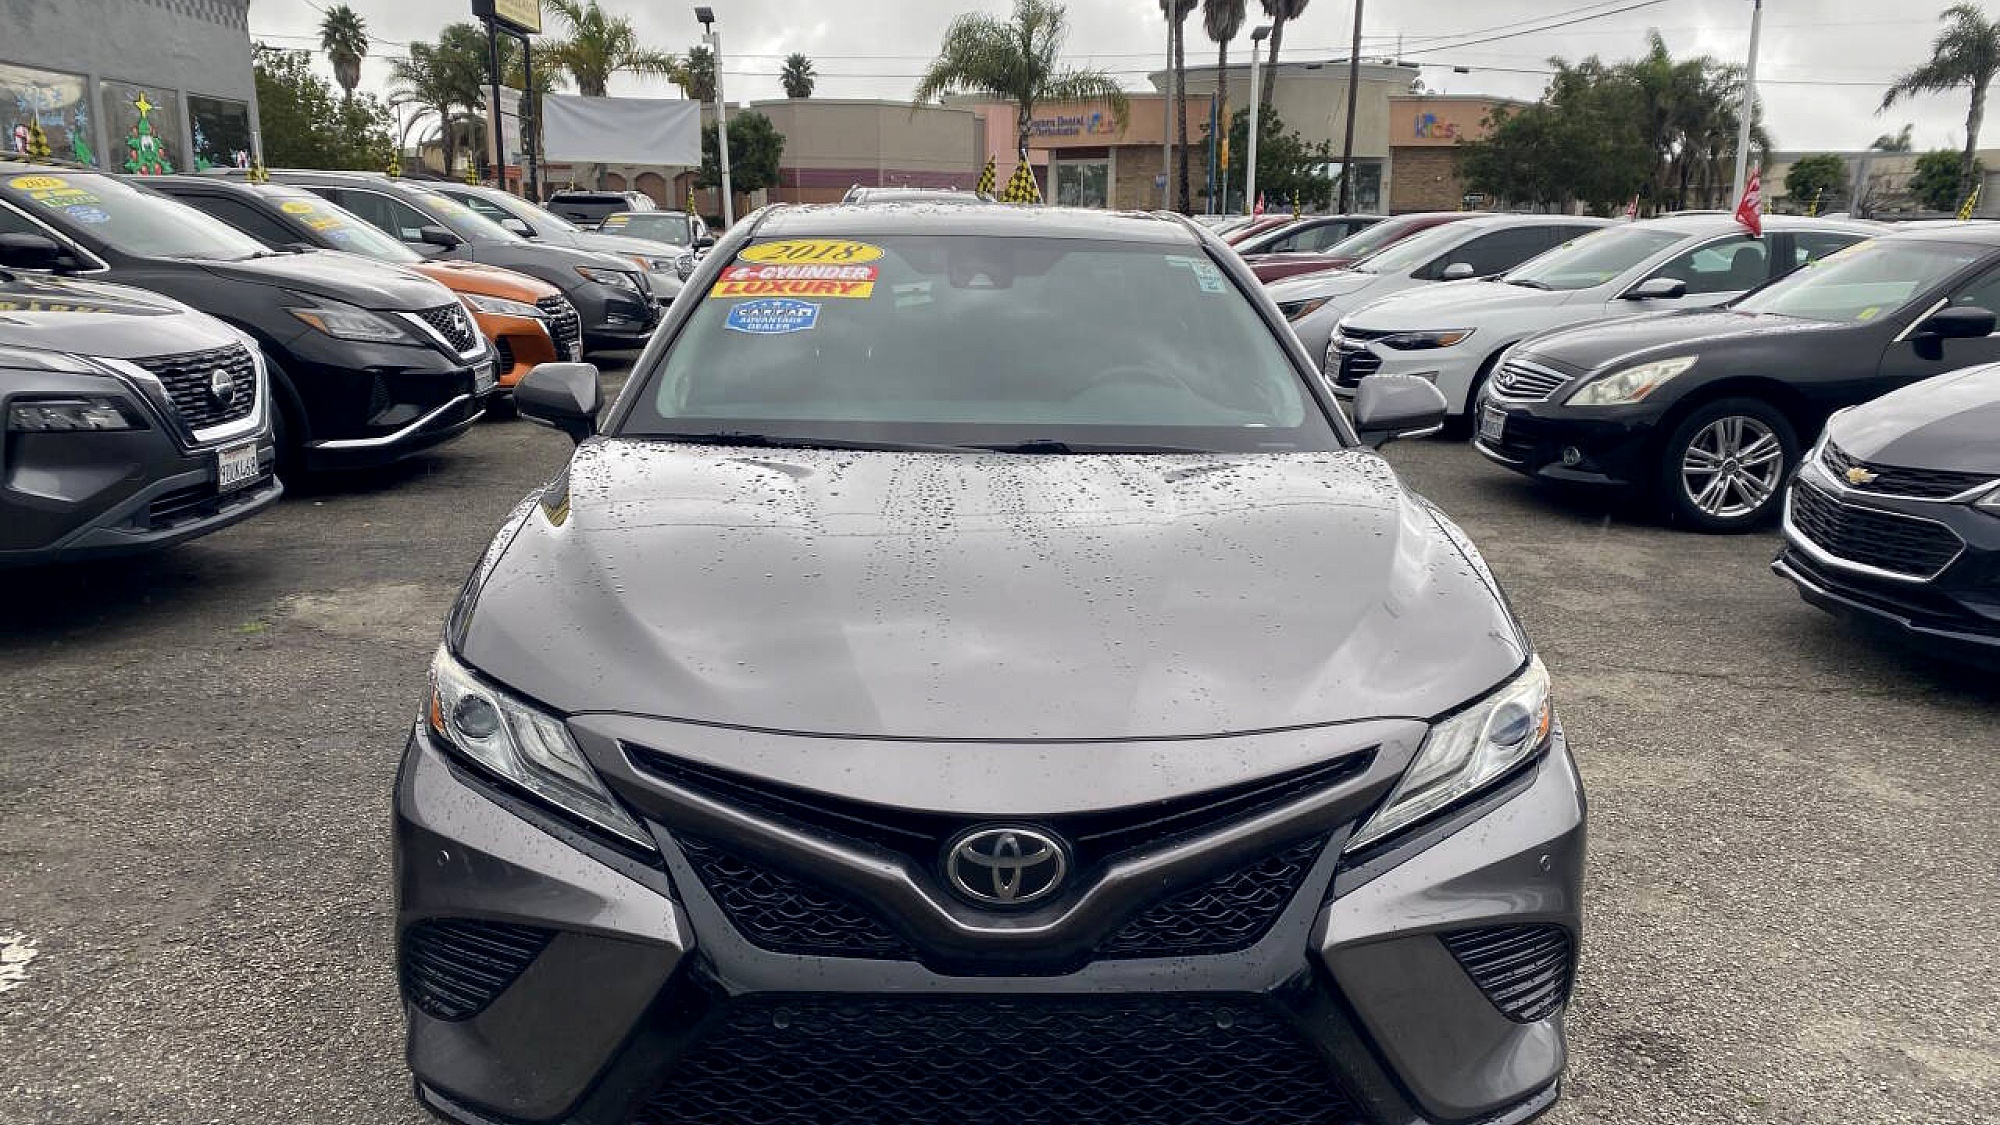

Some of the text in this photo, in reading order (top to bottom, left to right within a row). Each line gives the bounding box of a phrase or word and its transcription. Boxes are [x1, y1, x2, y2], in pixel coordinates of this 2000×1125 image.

[761, 244, 864, 261] 2018
[728, 265, 871, 281] 4-CYLINDER
[721, 281, 860, 295] LUXURY
[746, 323, 791, 331] DEALER
